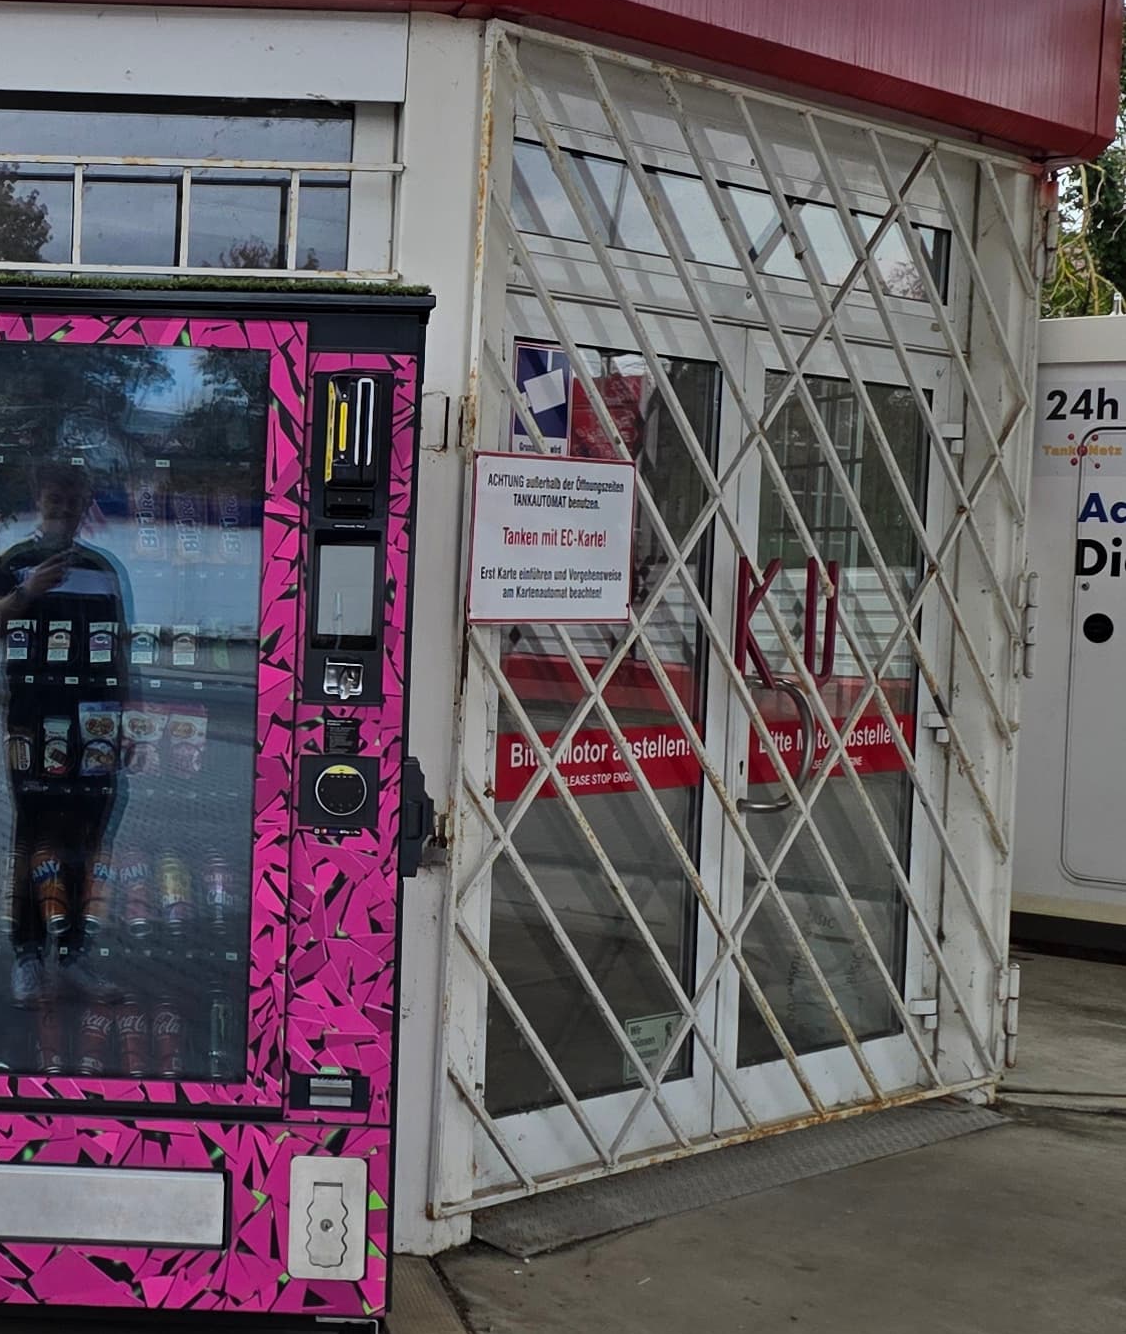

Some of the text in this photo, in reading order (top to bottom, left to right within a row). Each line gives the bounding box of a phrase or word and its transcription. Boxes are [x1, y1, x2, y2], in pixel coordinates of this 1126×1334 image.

[1045, 387, 1119, 420] 24h
[487, 473, 624, 495] ACHTUNG außerhalb der Öffnungszeiten
[513, 493, 601, 509] TANKAUTOMAT benutzen.
[502, 526, 607, 548] Tanken mit EC-Karte!
[1075, 536, 1126, 578] Di
[480, 566, 622, 584] Erst Karte einführen und Vorgehensweise
[502, 586, 602, 599] am Kartenautomat beachten!
[554, 739, 609, 765] Motor
[592, 773, 612, 785] STOP
[613, 771, 635, 784] ENGI
